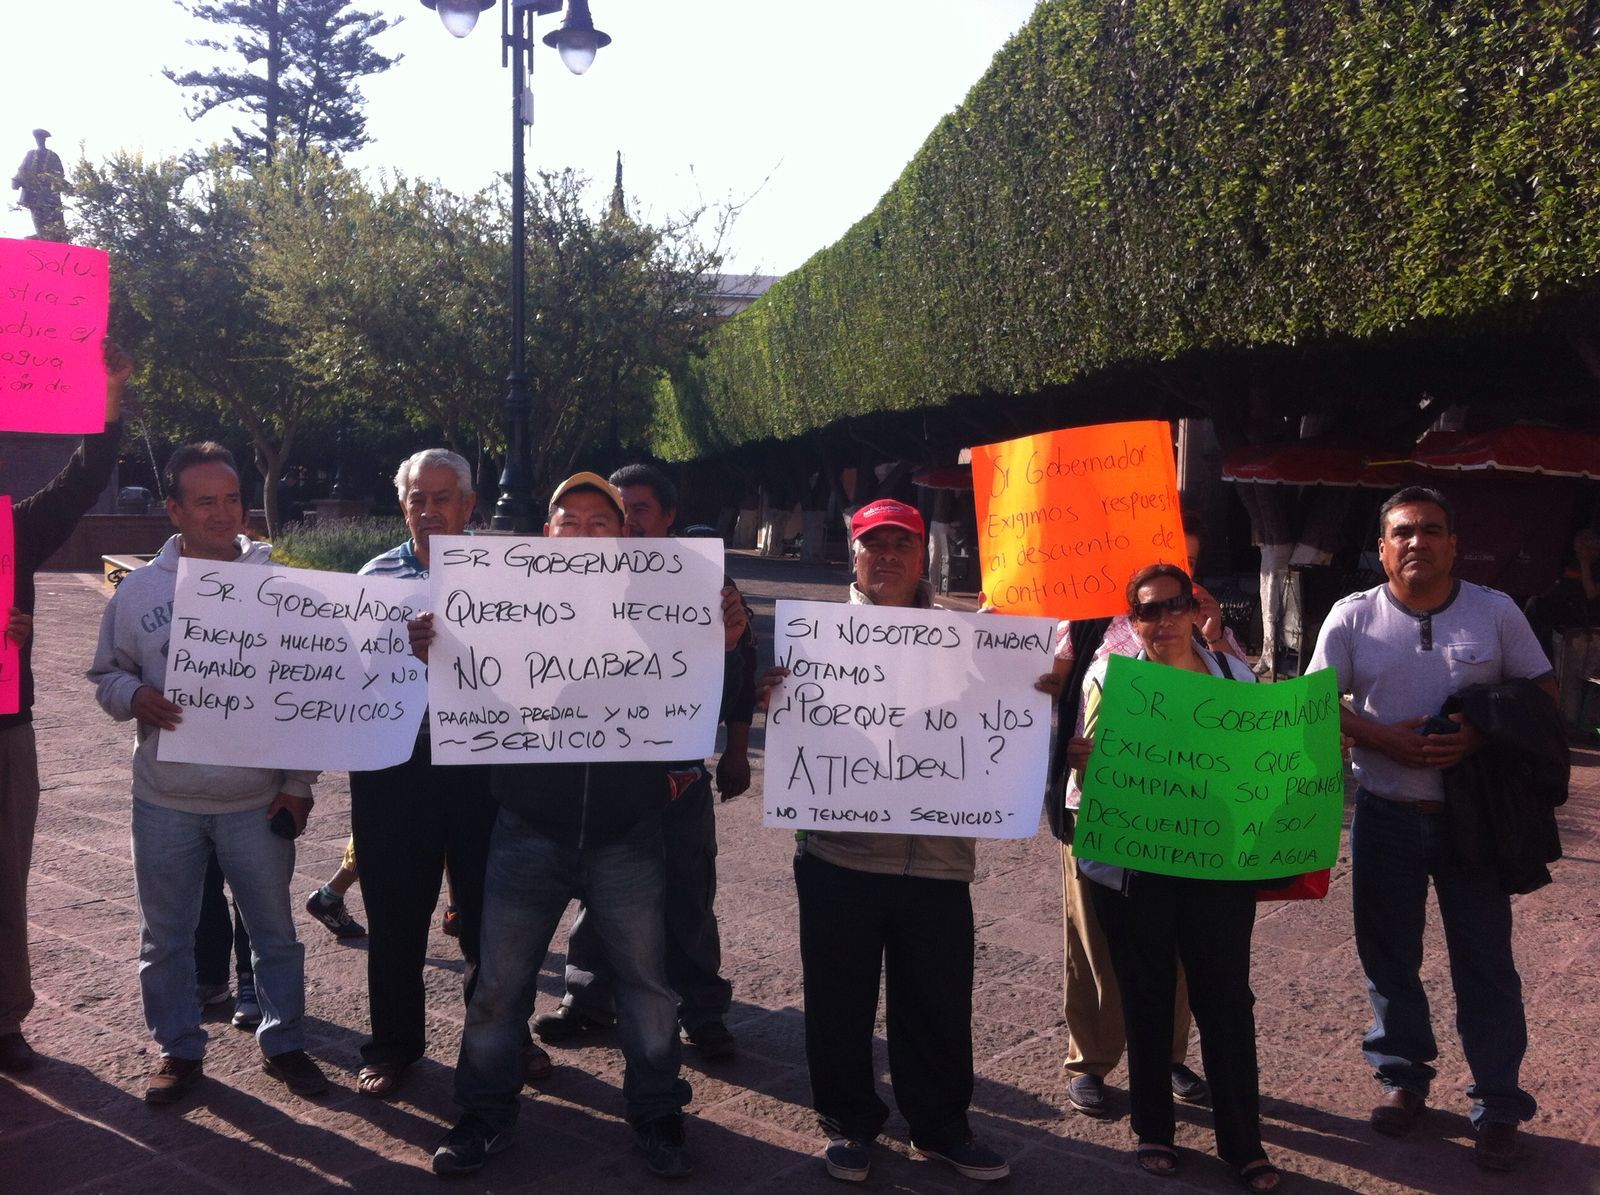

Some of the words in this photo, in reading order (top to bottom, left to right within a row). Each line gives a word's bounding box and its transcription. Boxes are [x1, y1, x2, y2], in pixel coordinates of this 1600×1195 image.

[1, 350, 64, 370] agua
[45, 378, 72, 394] de
[987, 504, 1079, 540] Exigimos
[442, 548, 491, 567] SR
[503, 543, 683, 578] GOBERNADOS
[1016, 531, 1130, 567] descuento
[1151, 524, 1176, 550] de
[445, 589, 576, 628] QUEREMOS
[611, 602, 713, 626] HECHOS
[178, 617, 268, 661] TENEMOS
[280, 633, 348, 653] MUCHOS
[785, 617, 819, 640] SI
[838, 615, 961, 648] NOSOTROS
[974, 626, 1053, 654] TAMBIEN
[173, 649, 257, 681] PAGANDO
[268, 660, 347, 684] PREDIAL
[361, 672, 380, 690] Y
[391, 666, 418, 684] NO
[453, 646, 502, 690] NO
[524, 650, 688, 689] PALABRAS
[780, 645, 886, 683] VOTAMOS
[168, 686, 255, 721] TENEMOS
[274, 691, 405, 723] SERVICIOS
[437, 706, 510, 727] PAGANDO
[519, 705, 589, 723] PREDIAL
[604, 705, 621, 722] Y
[627, 706, 651, 720] NO
[665, 703, 703, 721] HAY
[773, 682, 907, 726] ¿PORQUE
[925, 708, 958, 732] NO
[979, 699, 1034, 731] NOS
[1192, 691, 1337, 733] GOBERNADOR
[1099, 728, 1231, 773] EXIGIMOS
[1254, 750, 1301, 774] QUE
[1234, 782, 1269, 803] SU
[808, 807, 891, 823] TENEMOS
[1086, 798, 1221, 838] DESCUENTO
[1113, 836, 1225, 869] CONTRATO
[1237, 851, 1259, 867] DE
[1269, 848, 1320, 865] AGUA
